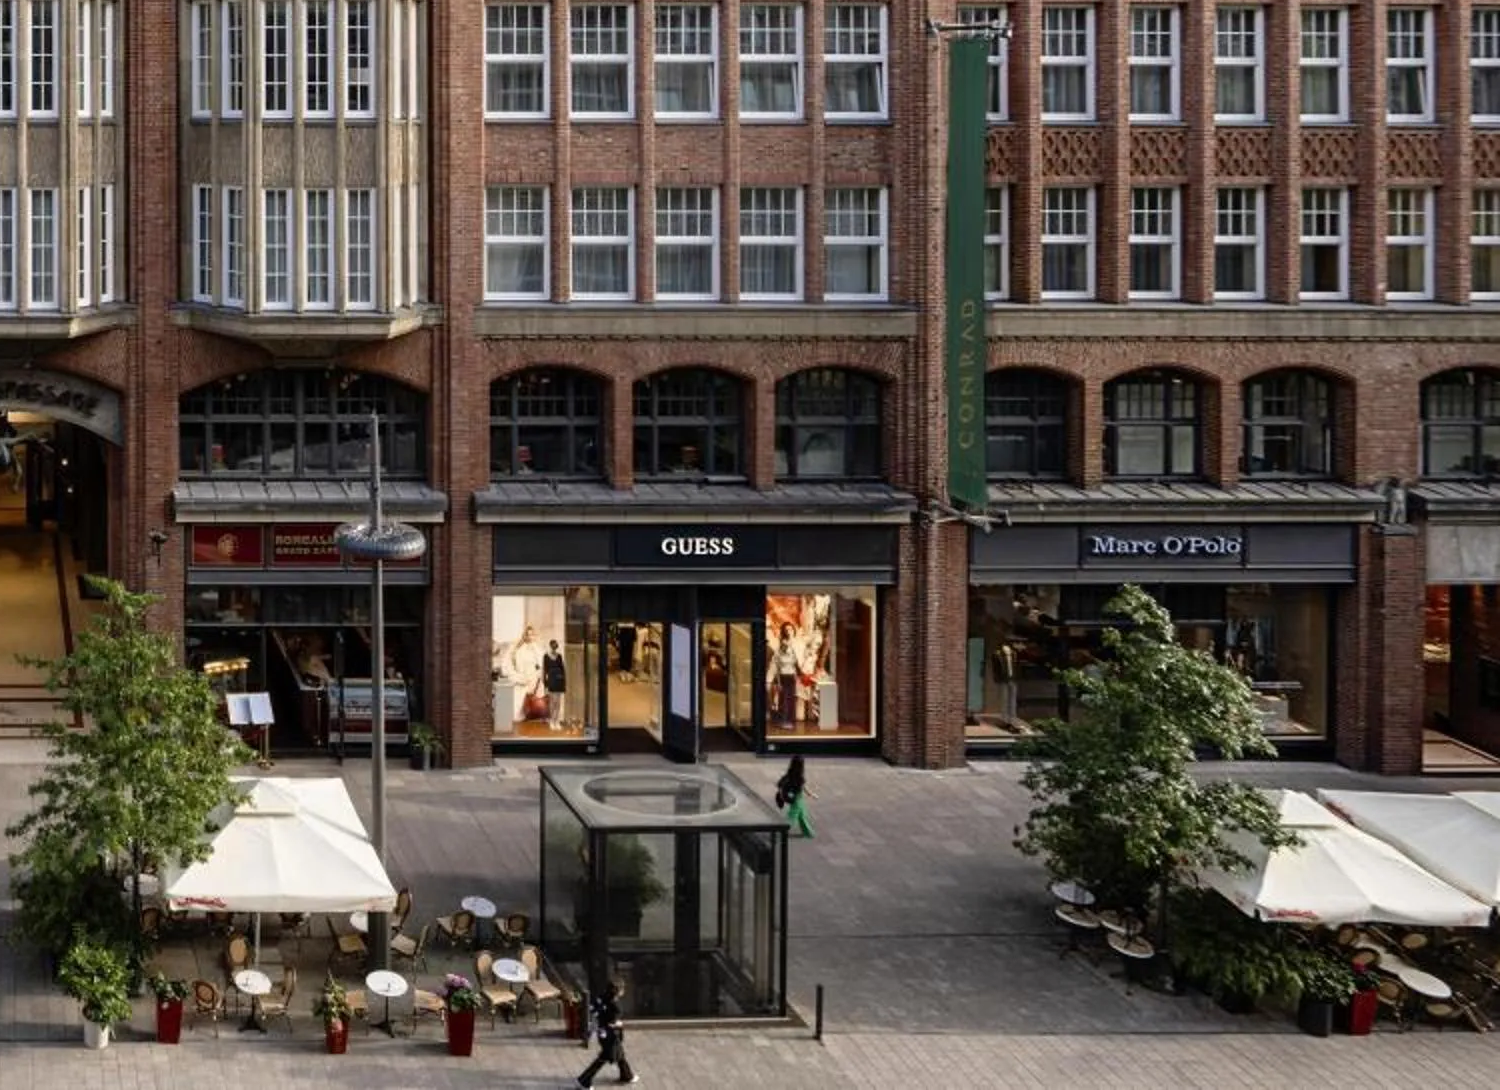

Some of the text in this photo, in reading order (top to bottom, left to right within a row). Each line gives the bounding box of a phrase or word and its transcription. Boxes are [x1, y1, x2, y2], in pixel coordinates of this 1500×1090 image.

[958, 299, 975, 450] CONRAD
[661, 537, 734, 555] GUESS
[1092, 536, 1241, 555] Marc O'Polo
